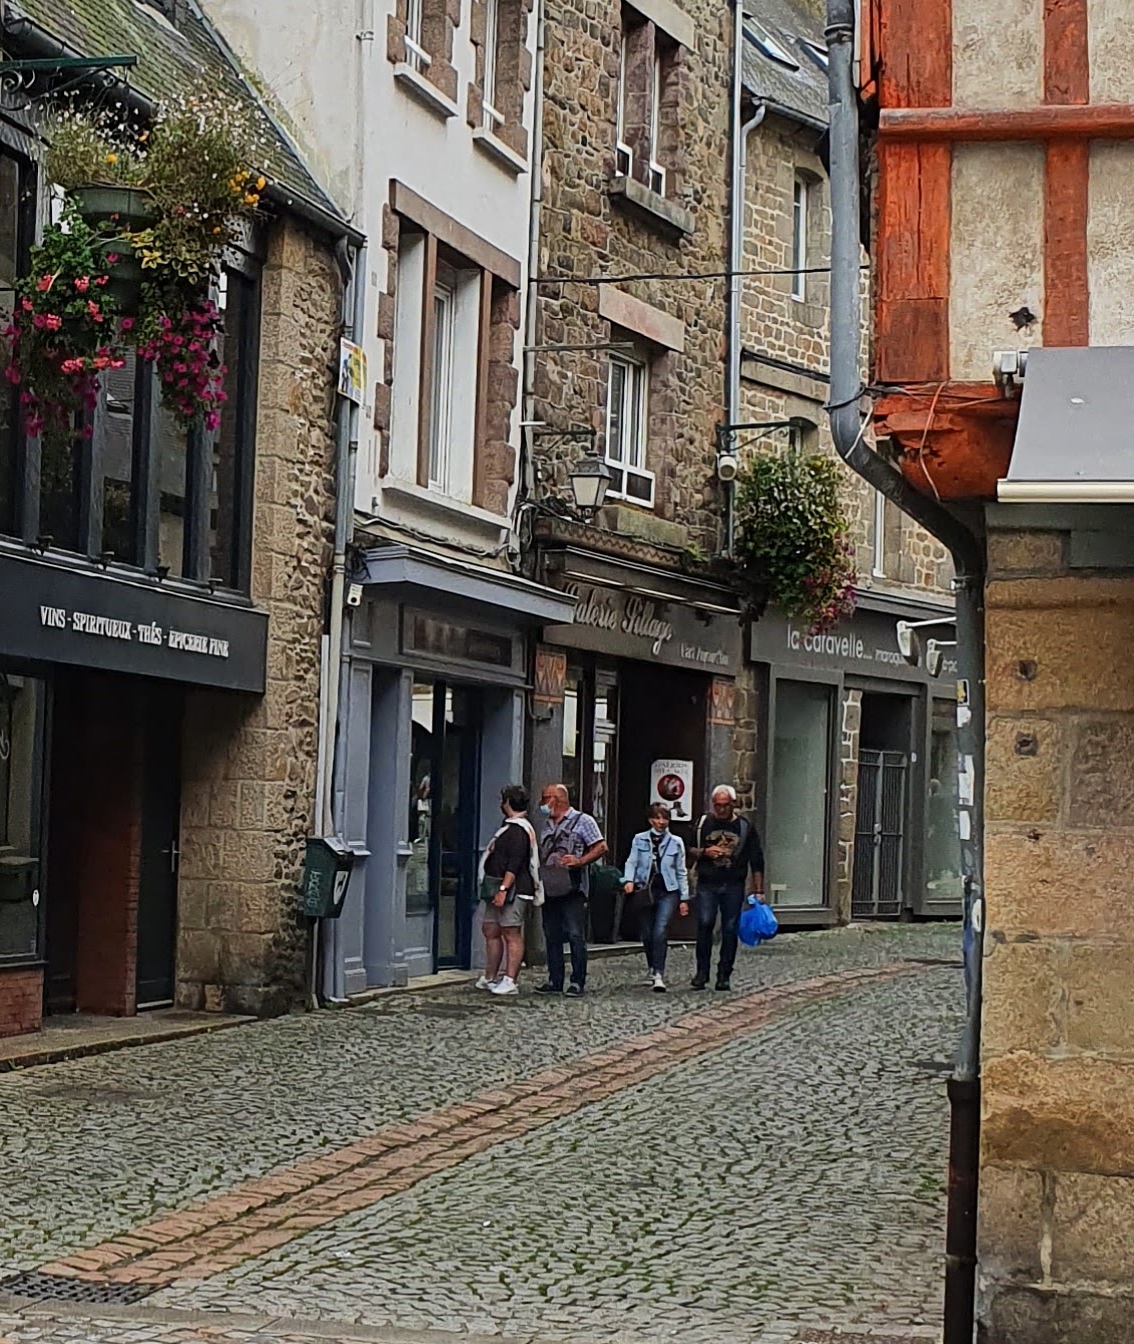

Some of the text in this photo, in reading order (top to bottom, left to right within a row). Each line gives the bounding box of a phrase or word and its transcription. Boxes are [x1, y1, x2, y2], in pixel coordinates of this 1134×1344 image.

[40, 605, 66, 629] VINS
[72, 611, 132, 640] SPIRITUEUX
[209, 637, 230, 658] FINE
[787, 623, 800, 650] la
